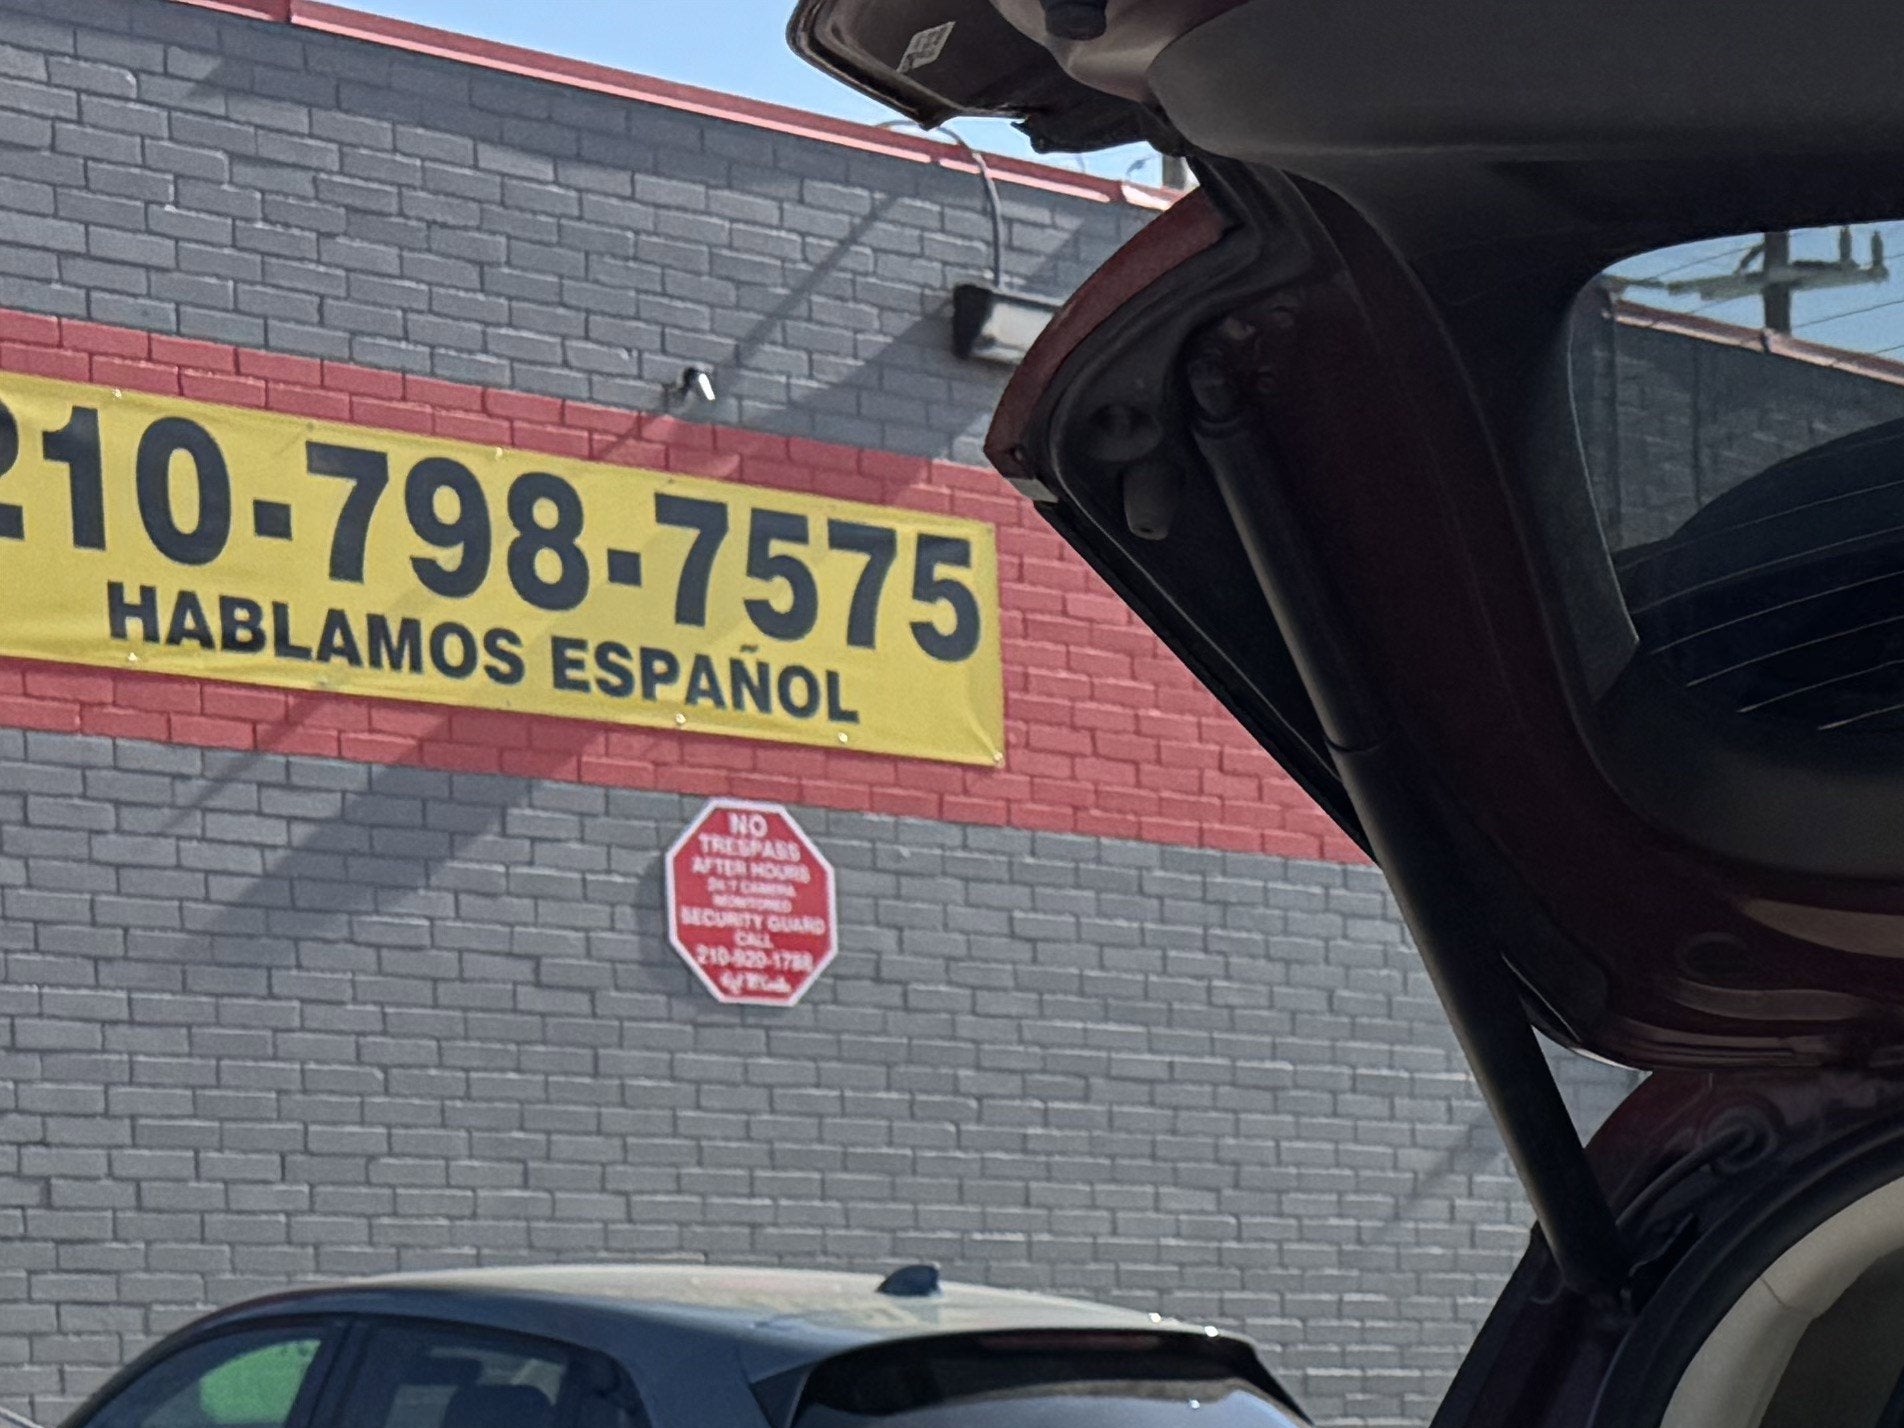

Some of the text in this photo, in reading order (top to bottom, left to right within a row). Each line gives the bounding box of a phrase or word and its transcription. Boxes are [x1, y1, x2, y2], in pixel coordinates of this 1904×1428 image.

[0, 402, 981, 662] 10-798-7575
[107, 581, 860, 724] HABLAMOS ESPAÑOL
[728, 812, 768, 838] NO
[698, 833, 801, 863] TRESPASS
[691, 856, 811, 885] AFTER HOURS
[680, 905, 826, 936] SECURITY GUARD
[733, 929, 774, 950] CALL
